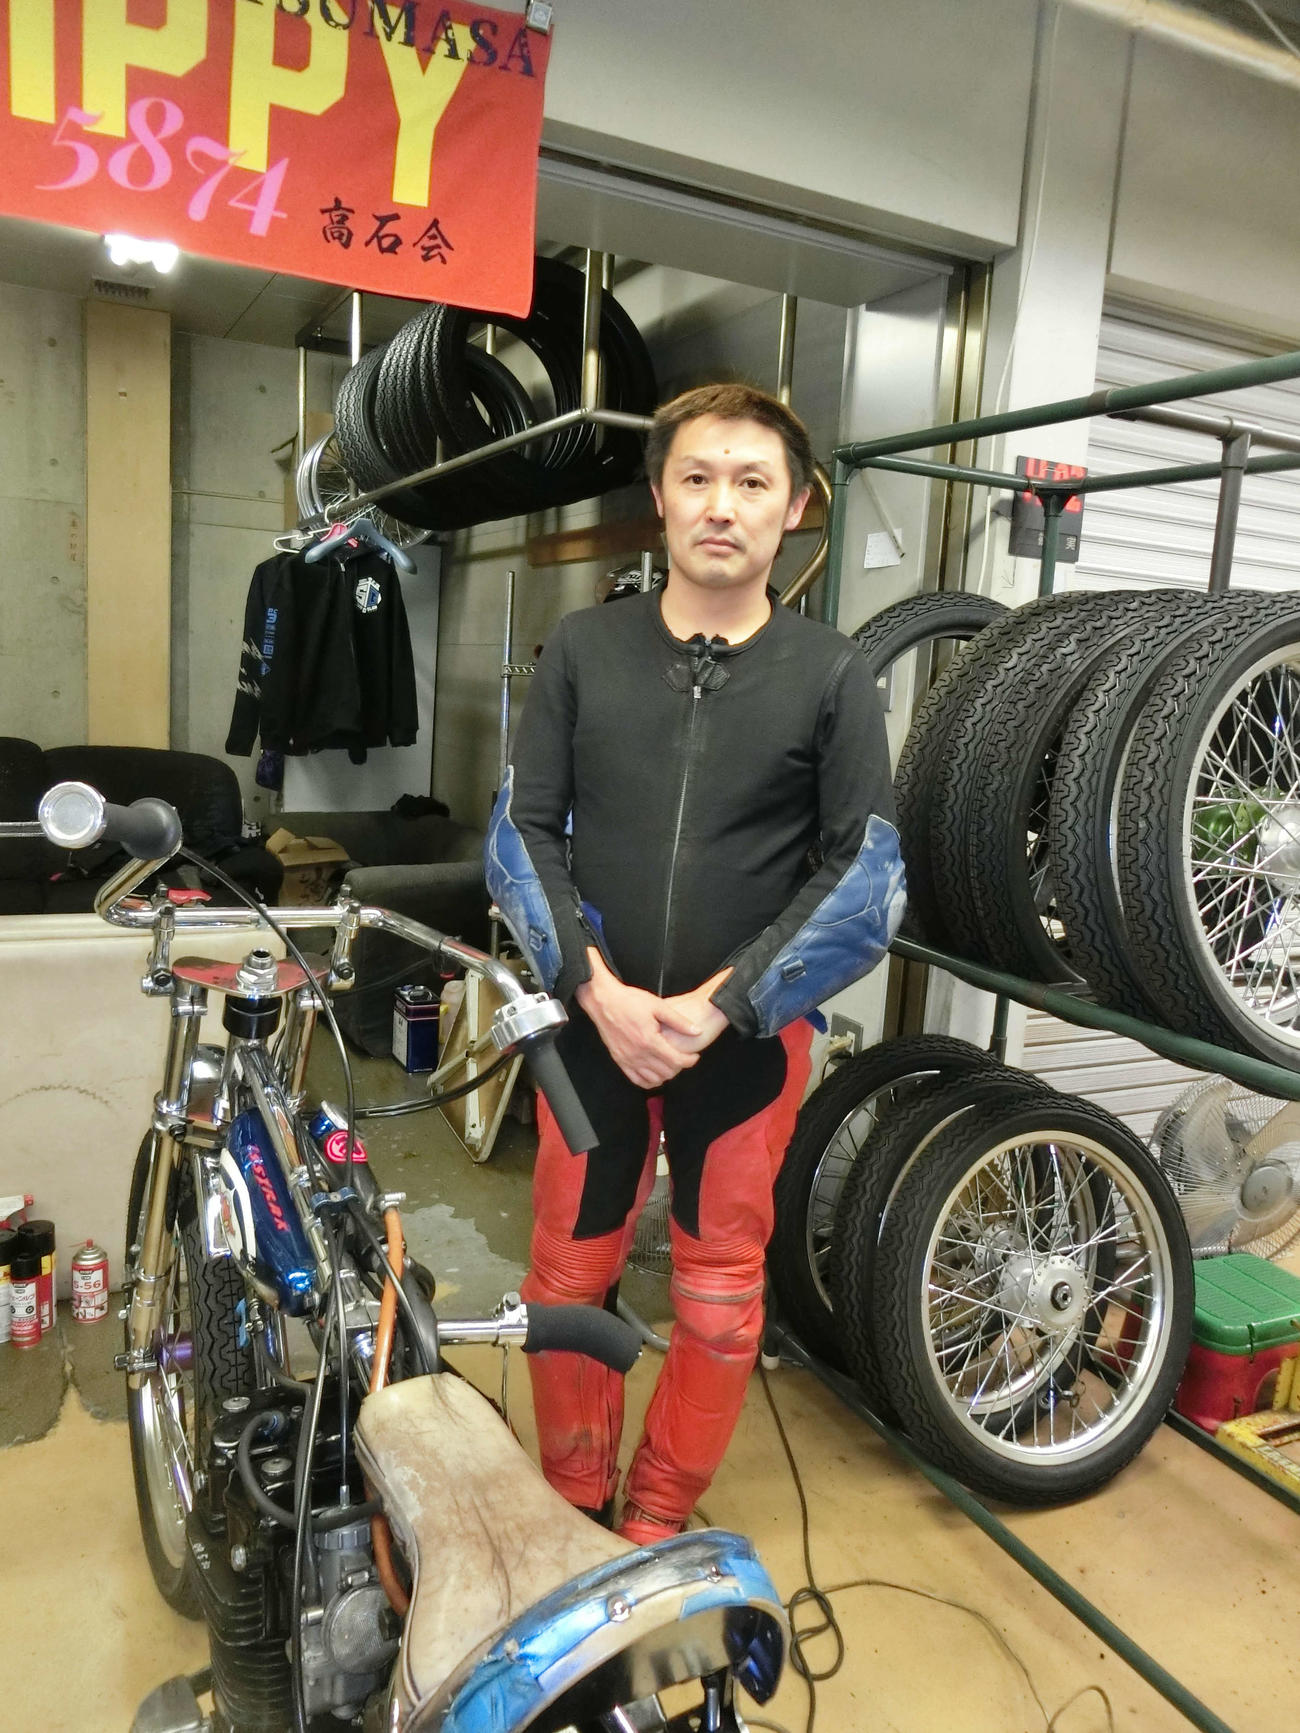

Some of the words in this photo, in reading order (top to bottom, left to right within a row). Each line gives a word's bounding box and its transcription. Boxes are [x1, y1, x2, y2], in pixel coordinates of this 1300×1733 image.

[34, 97, 289, 236] 5874
[319, 196, 455, 265] 高石会
